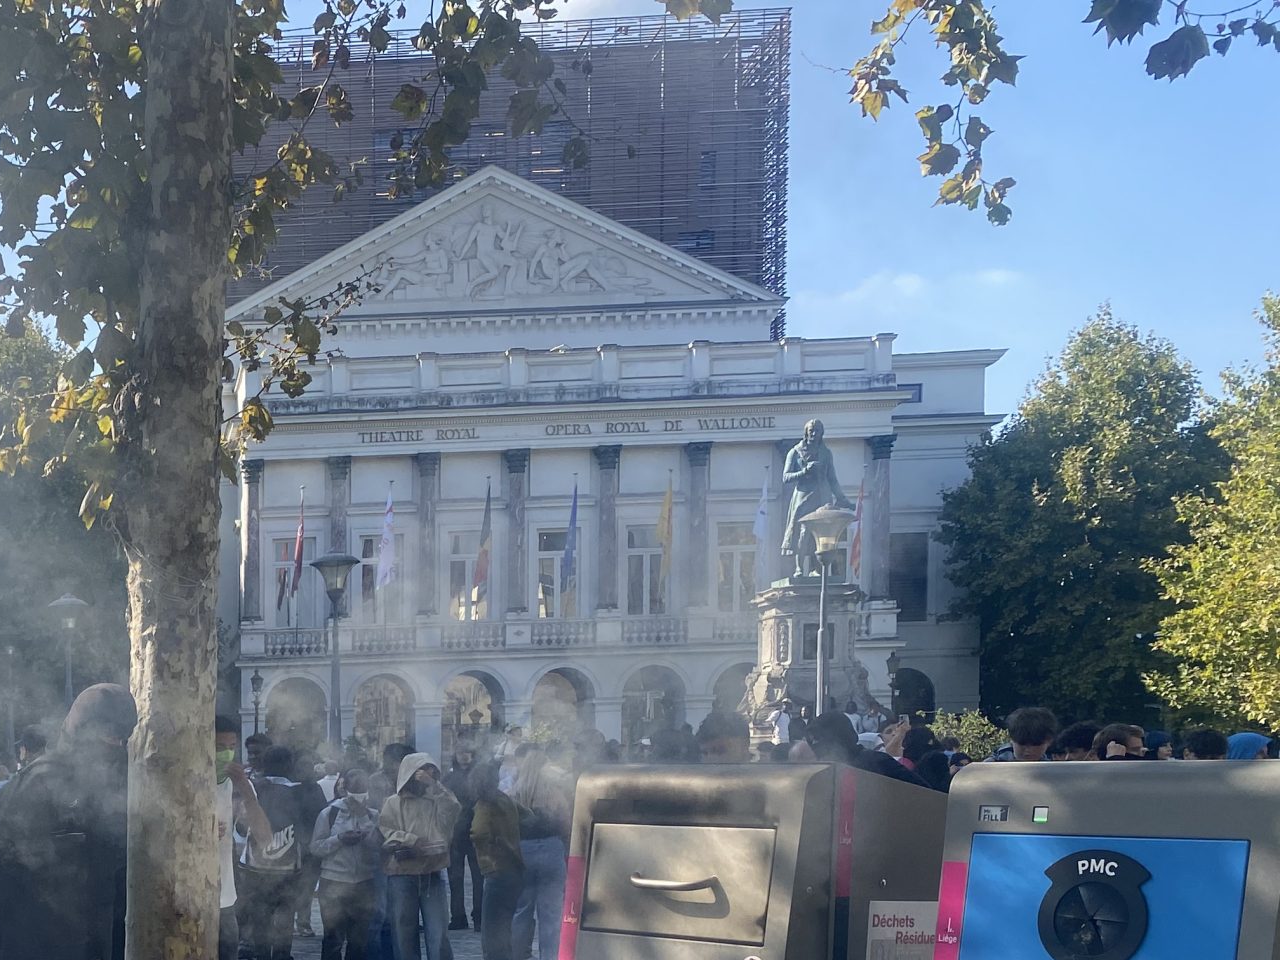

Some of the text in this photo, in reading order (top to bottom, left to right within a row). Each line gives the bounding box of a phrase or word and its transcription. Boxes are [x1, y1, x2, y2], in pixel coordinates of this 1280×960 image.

[545, 416, 776, 436] OPERA ROYAL DE WALLONIE
[358, 427, 480, 444] THEATRE ROYAL
[983, 814, 999, 822] FILL
[1077, 858, 1119, 876] PMC
[871, 913, 916, 928] Déchets
